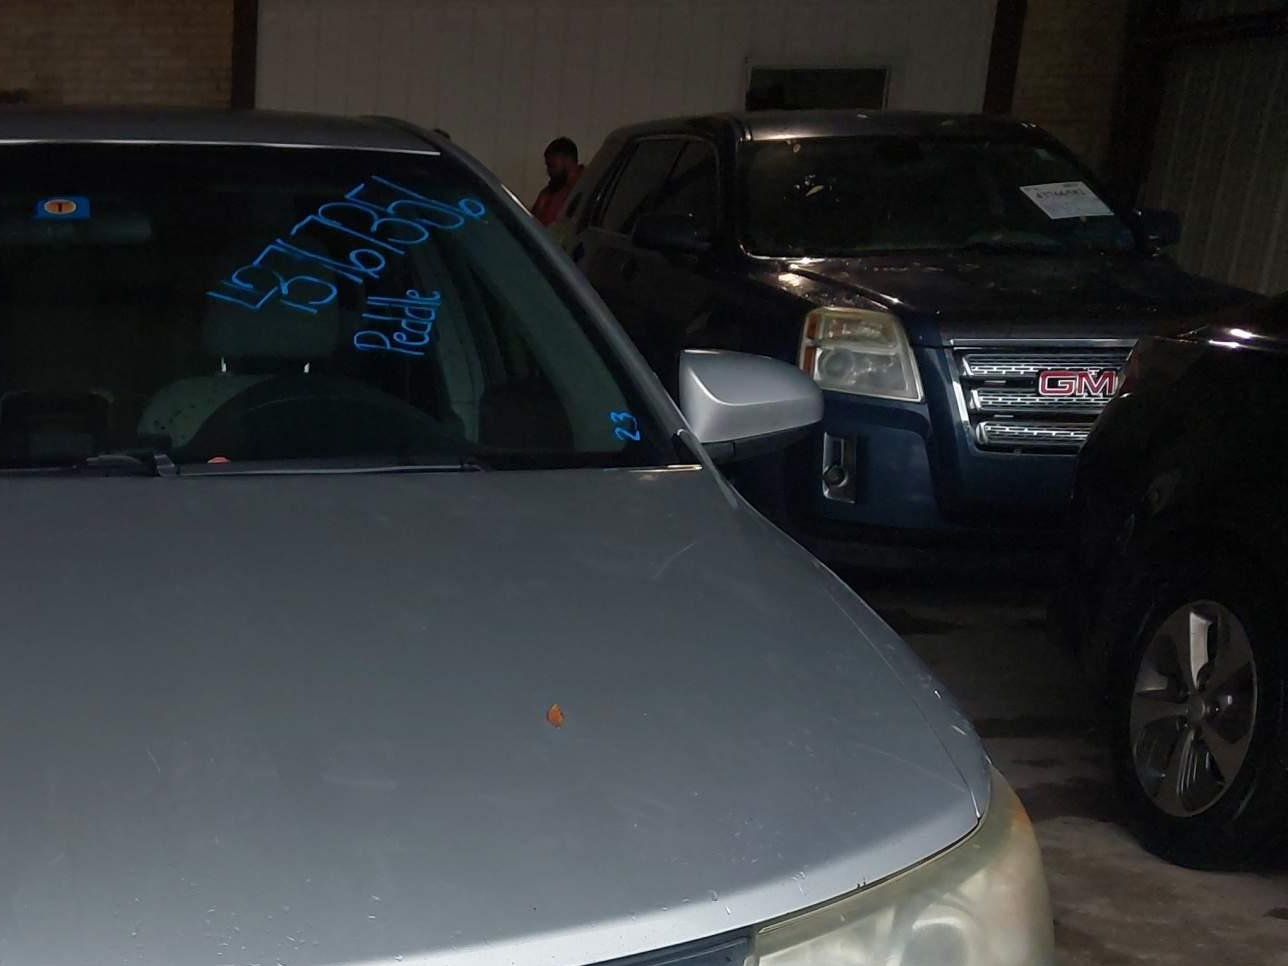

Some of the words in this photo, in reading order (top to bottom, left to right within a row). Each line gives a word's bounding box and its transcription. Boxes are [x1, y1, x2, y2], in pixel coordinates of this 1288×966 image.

[353, 288, 441, 356] Peddle
[1038, 370, 1118, 396] GM
[609, 410, 642, 442] 23
